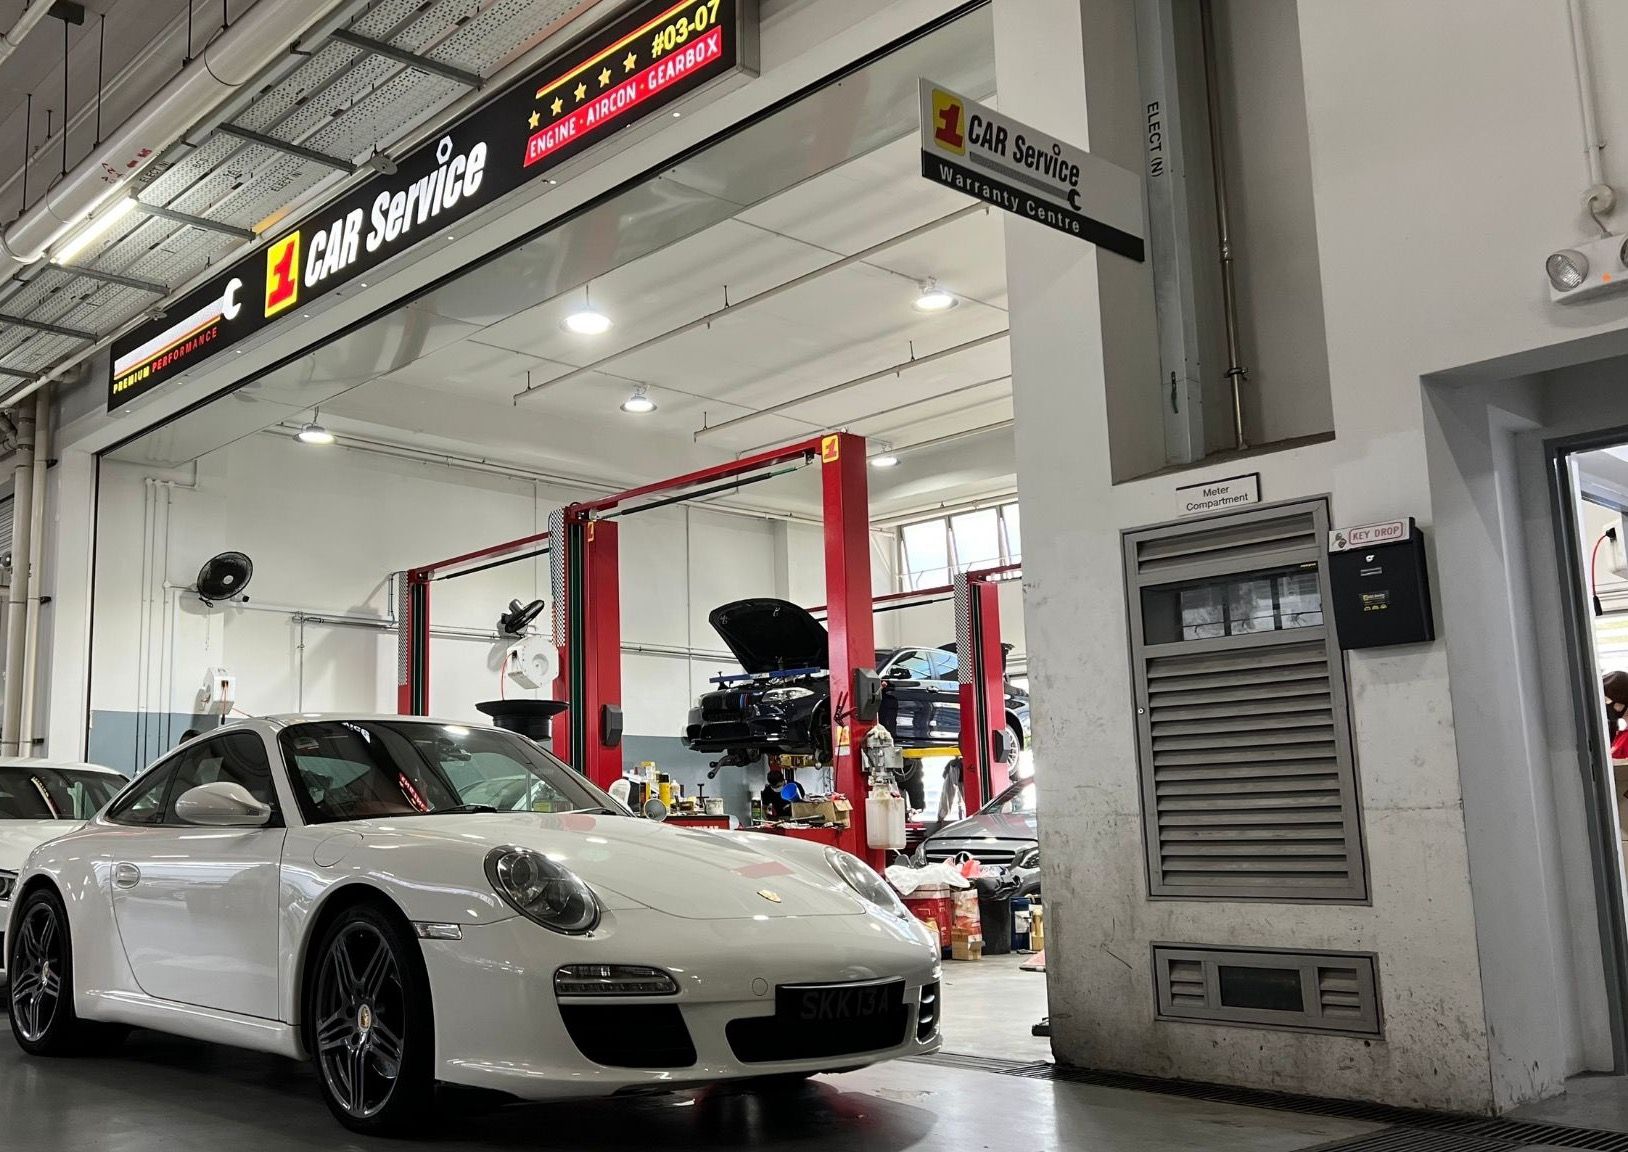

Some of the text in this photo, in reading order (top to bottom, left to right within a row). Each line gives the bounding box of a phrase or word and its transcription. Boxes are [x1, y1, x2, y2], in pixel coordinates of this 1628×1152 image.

[652, 0, 720, 58] #03-07
[529, 34, 719, 159] ENGINE AIRCON GEARBOX
[1147, 101, 1162, 152] ELECT
[936, 103, 1081, 187] 1 CAR Service
[267, 135, 488, 309] 1 CAR Service
[939, 164, 1081, 233] Warranty Centre
[112, 326, 218, 395] PREMIUM PERFORMANCE
[1186, 493, 1248, 511] Compartment
[1203, 486, 1230, 497] Meter
[1352, 526, 1399, 540] KEY DROP
